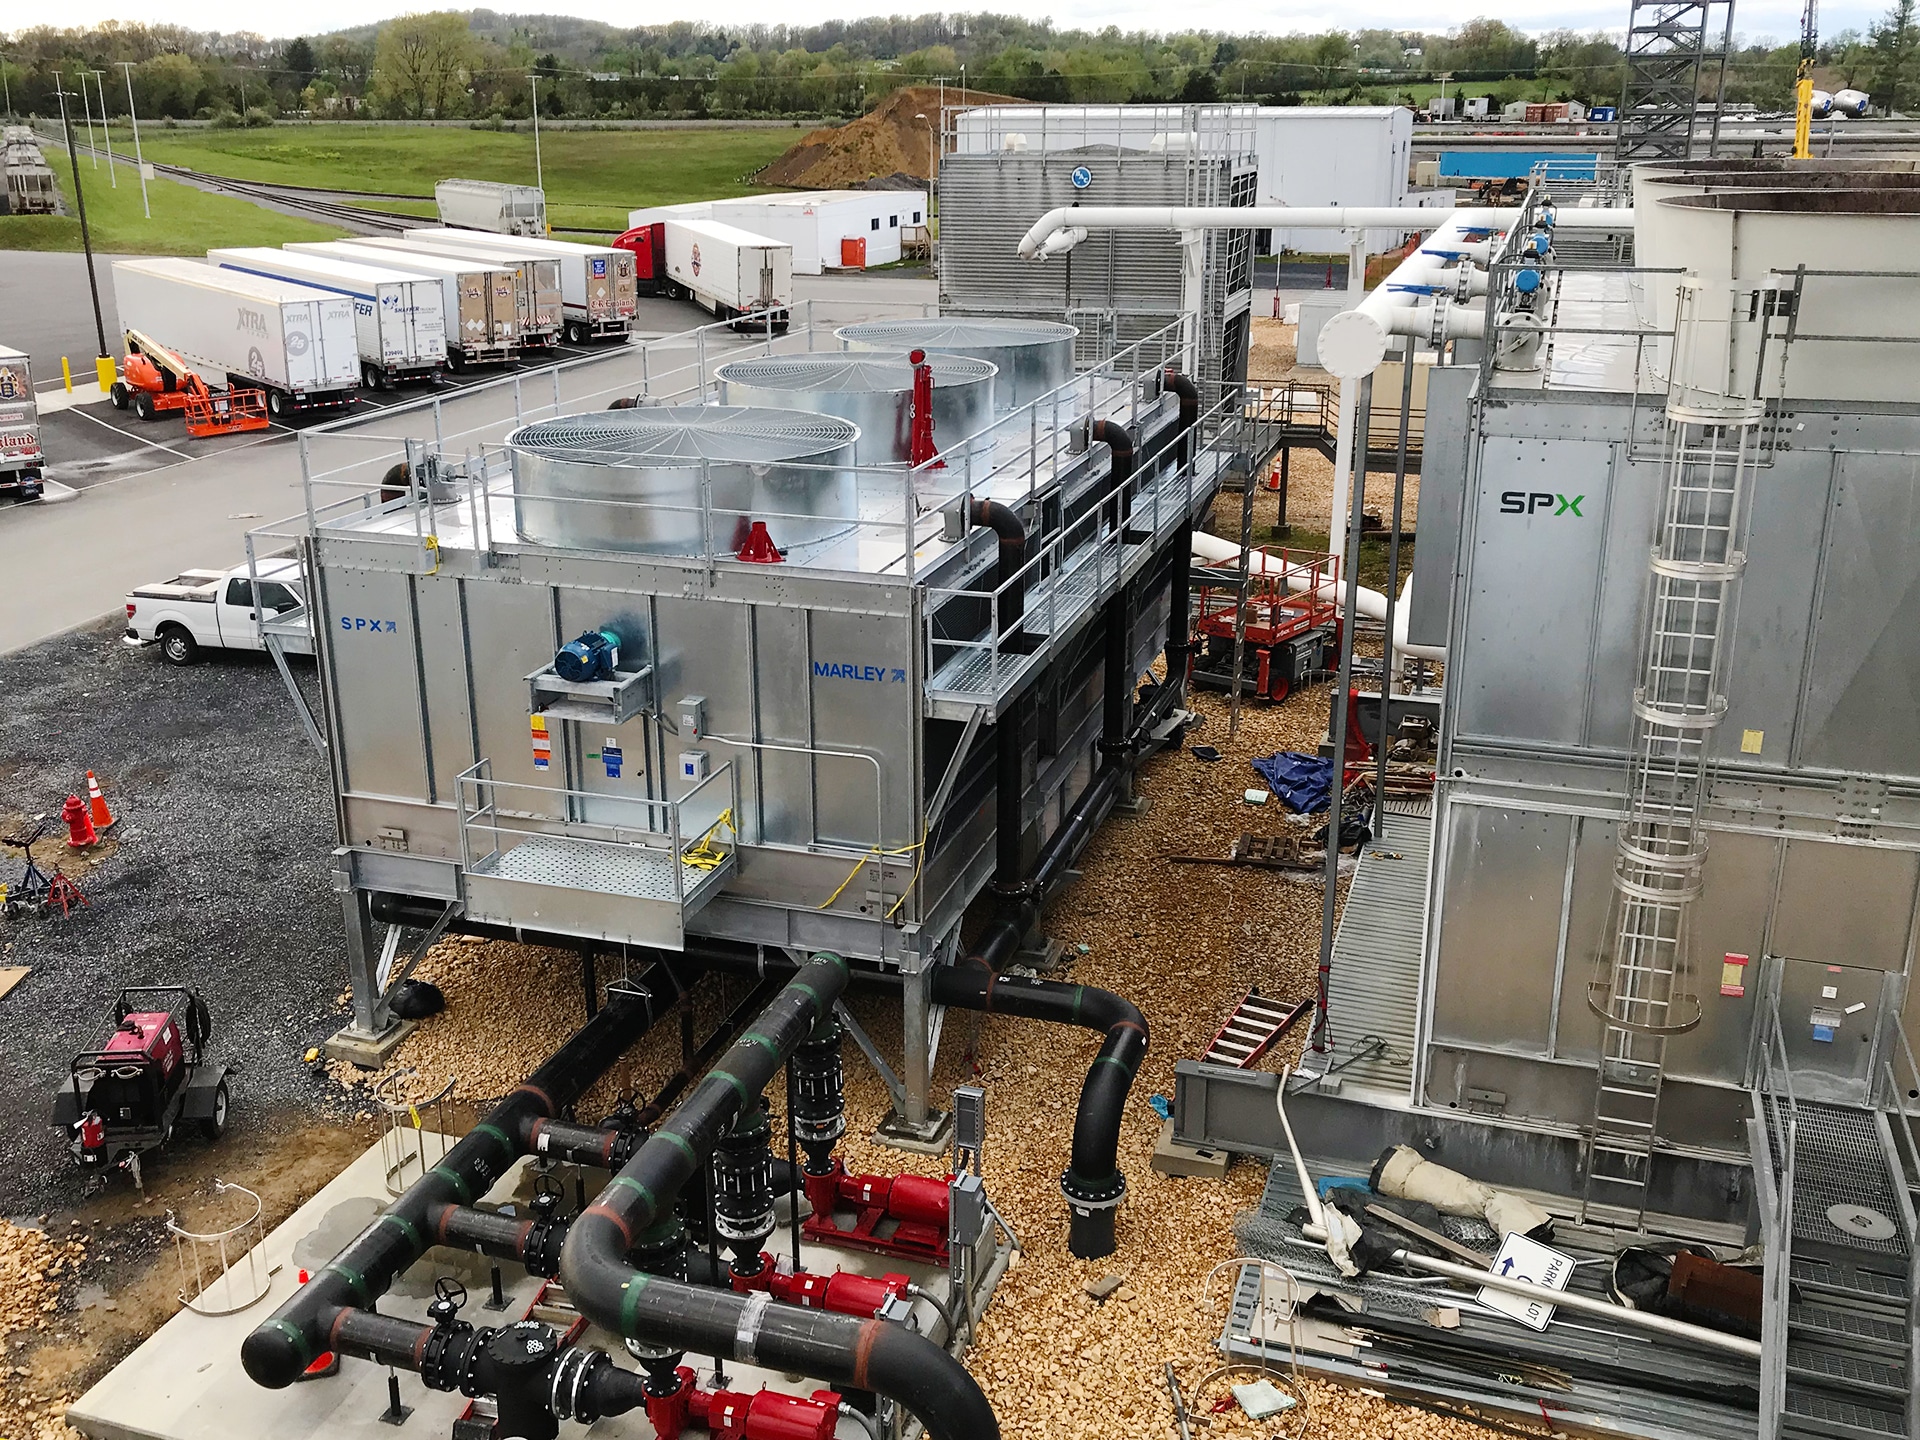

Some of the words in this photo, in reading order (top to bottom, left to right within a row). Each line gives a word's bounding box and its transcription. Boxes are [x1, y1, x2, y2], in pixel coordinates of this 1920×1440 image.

[236, 307, 268, 333] XTRA
[285, 313, 309, 324] XTRA
[327, 310, 350, 321] XTRA
[290, 335, 305, 350] 25
[251, 351, 264, 378] 25
[1500, 491, 1586, 518] SPX
[341, 616, 382, 632] SPX
[814, 661, 886, 682] MARLEY
[1526, 1302, 1543, 1322] LOT
